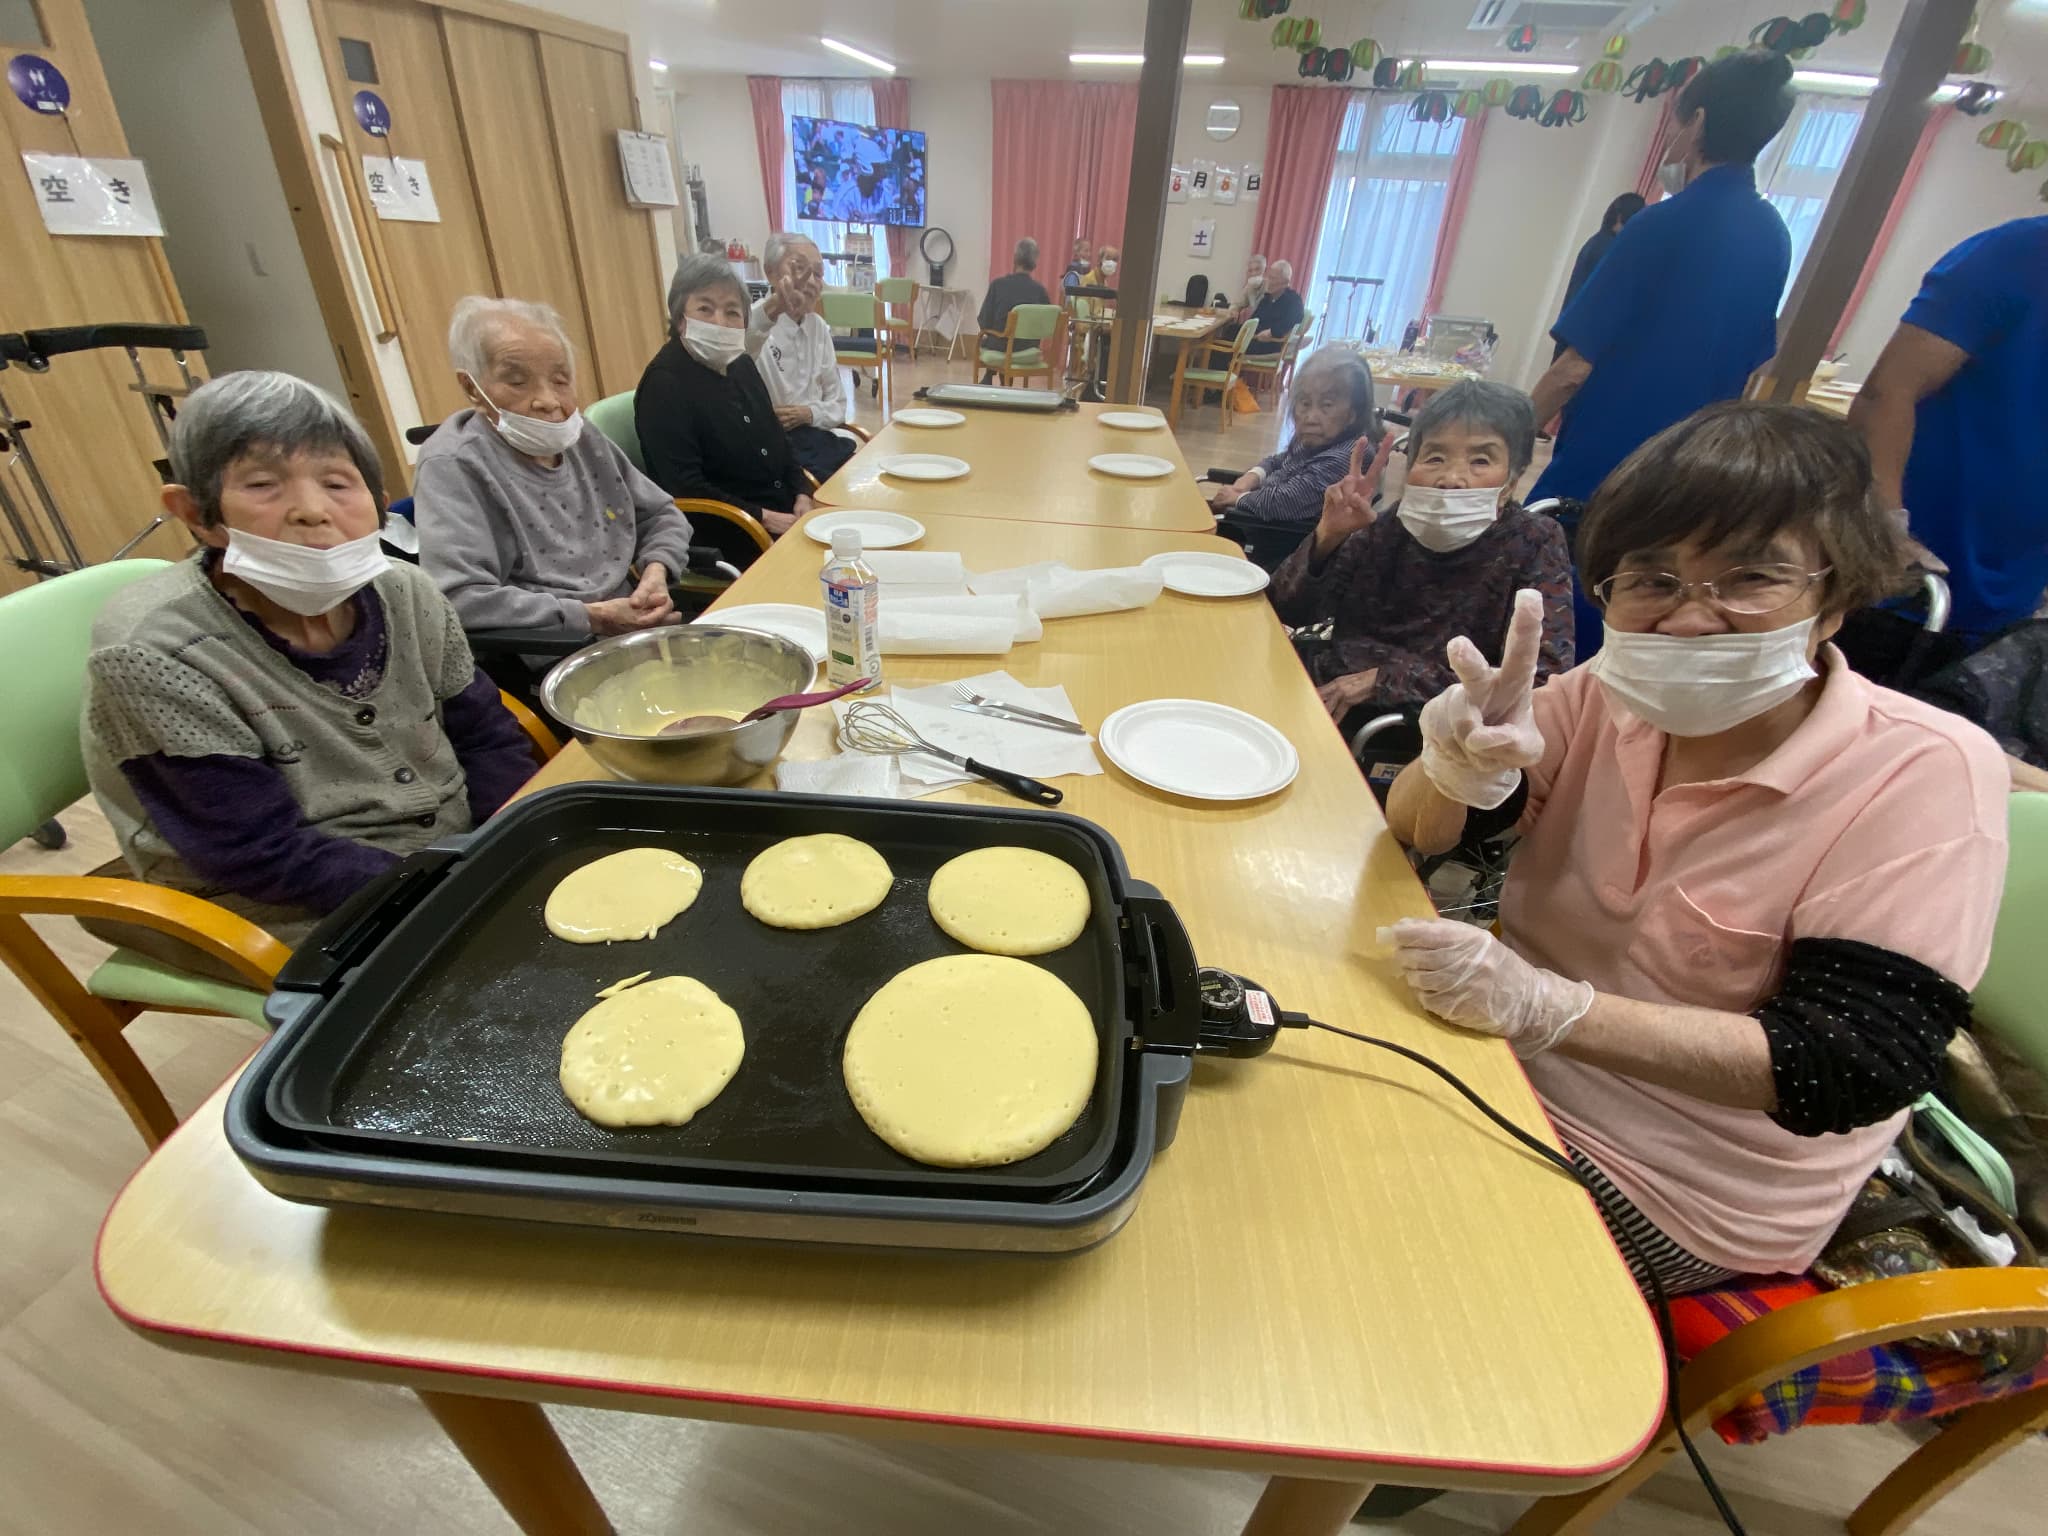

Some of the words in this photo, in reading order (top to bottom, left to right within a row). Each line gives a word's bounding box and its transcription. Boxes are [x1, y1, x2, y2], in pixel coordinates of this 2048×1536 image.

[40, 175, 130, 205] 空き
[368, 172, 420, 197] 空き
[1193, 230, 1208, 246] 土
